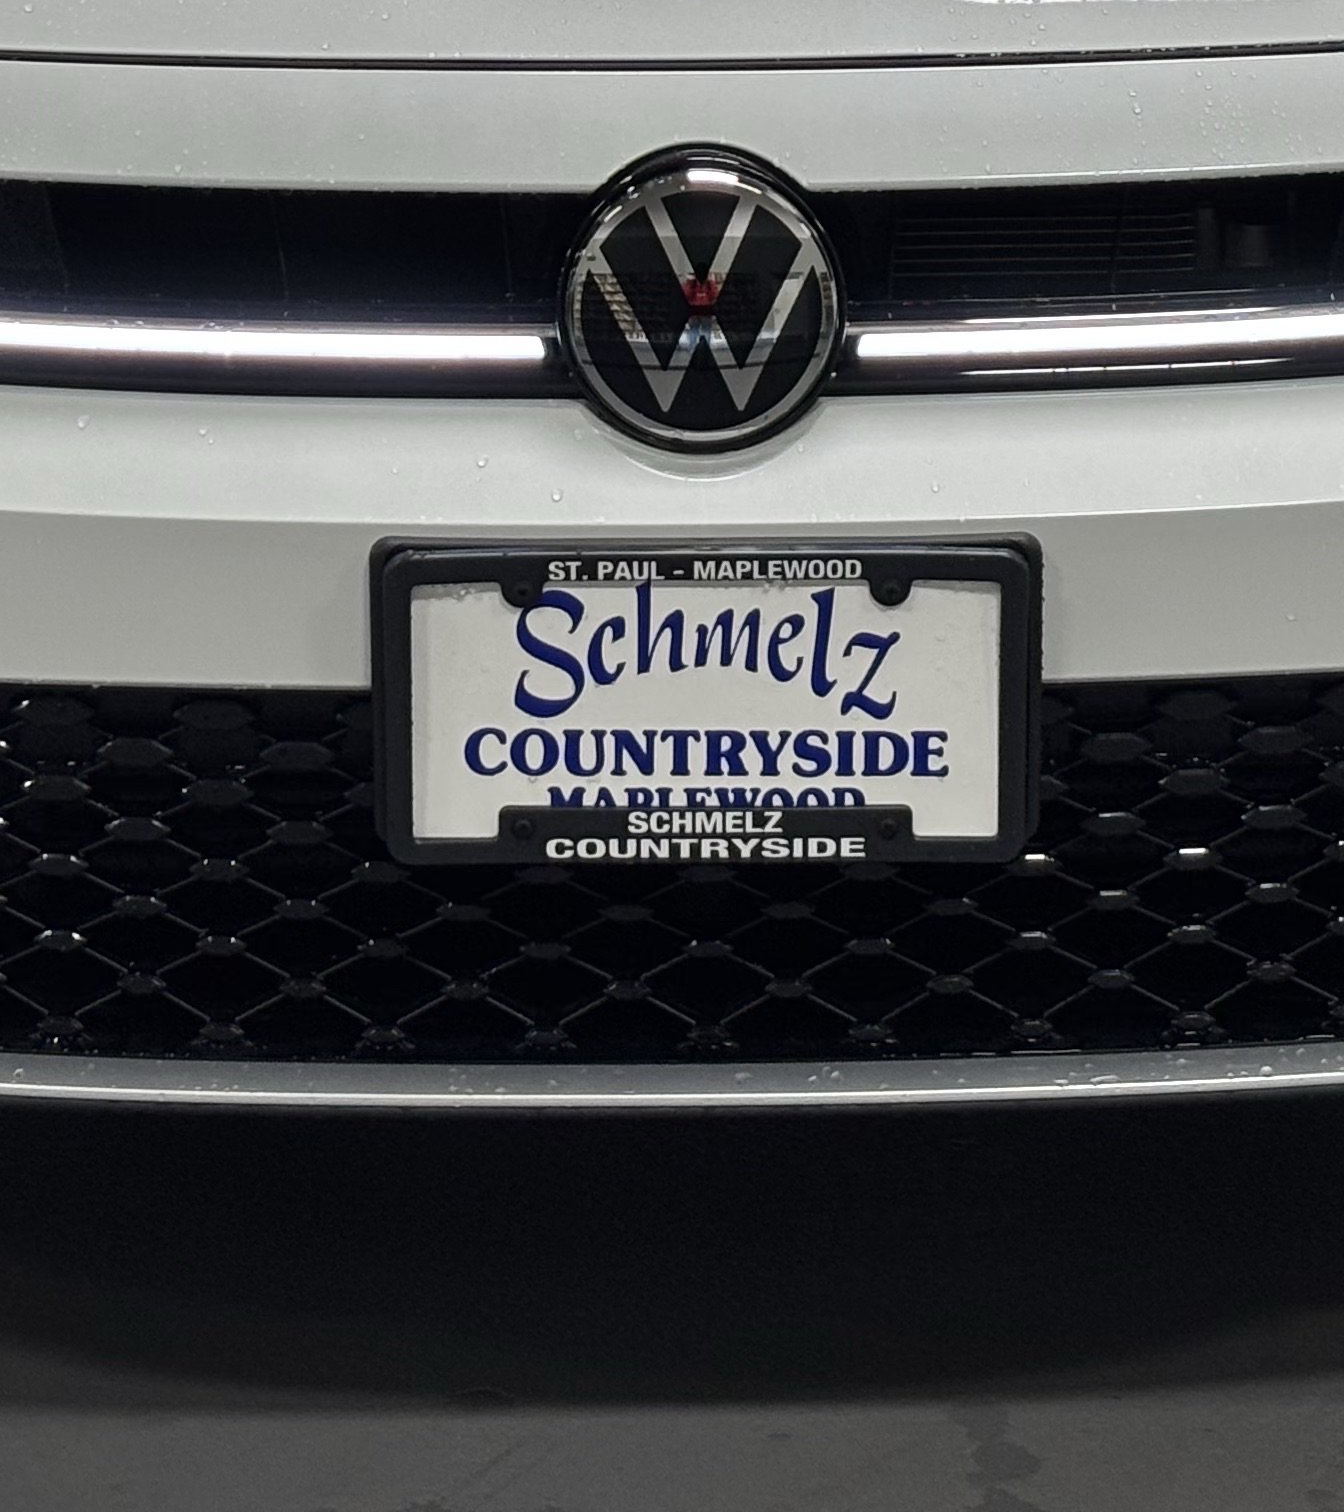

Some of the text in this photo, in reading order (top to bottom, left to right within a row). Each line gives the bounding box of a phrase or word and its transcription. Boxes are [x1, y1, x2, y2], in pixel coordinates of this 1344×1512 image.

[547, 560, 589, 581] ST.
[597, 560, 665, 581] PAUL
[693, 559, 863, 580] MAPLEWOOD
[513, 581, 901, 721] Schmelz
[463, 727, 949, 778] COUNTRYSIDE
[627, 811, 783, 834] SCHMELZ
[545, 837, 866, 859] COUNTRYSIDE
